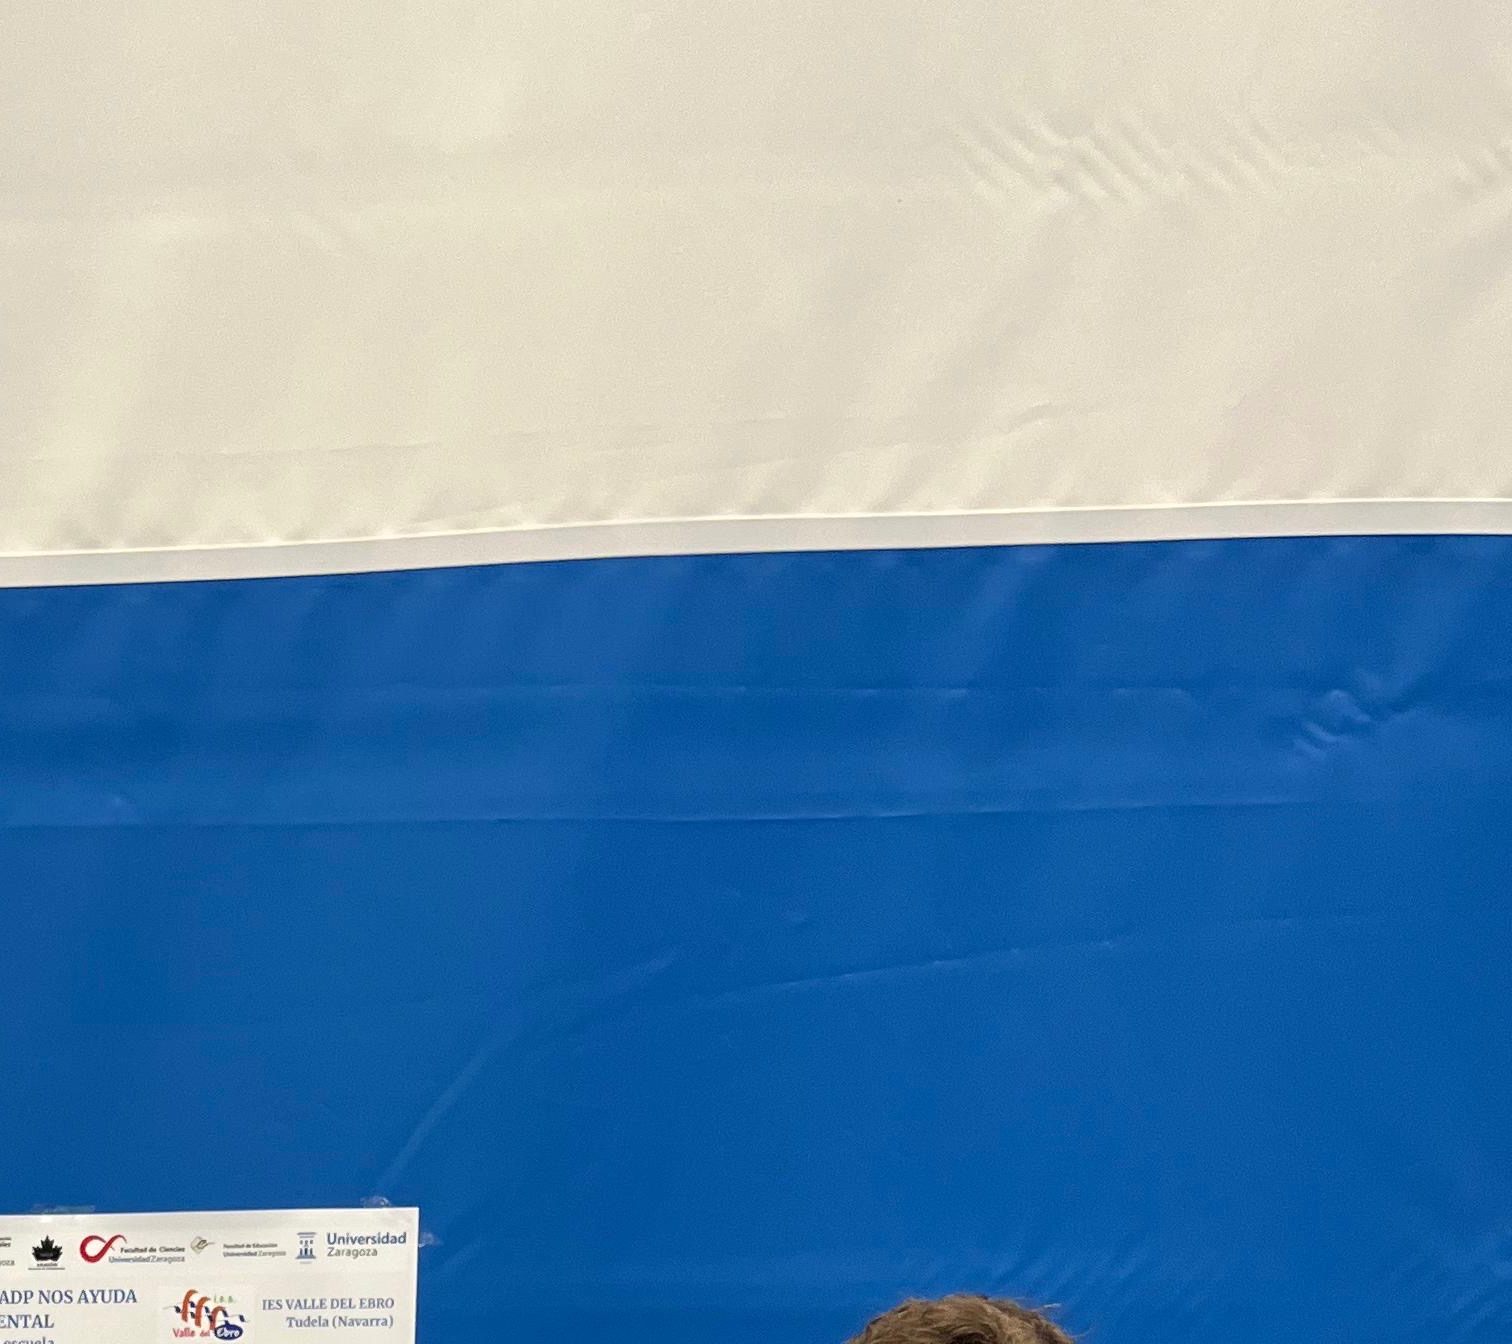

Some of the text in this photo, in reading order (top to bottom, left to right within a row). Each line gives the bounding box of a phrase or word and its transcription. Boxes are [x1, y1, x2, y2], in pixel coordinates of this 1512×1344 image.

[326, 1231, 407, 1249] Universidad
[326, 1246, 378, 1259] Zaragoza
[38, 1289, 73, 1304] NOS
[76, 1288, 137, 1304] AYUDA
[261, 1297, 395, 1310] IES VALLE DEL EBRO
[285, 1314, 393, 1329] Tudela (Navarra)
